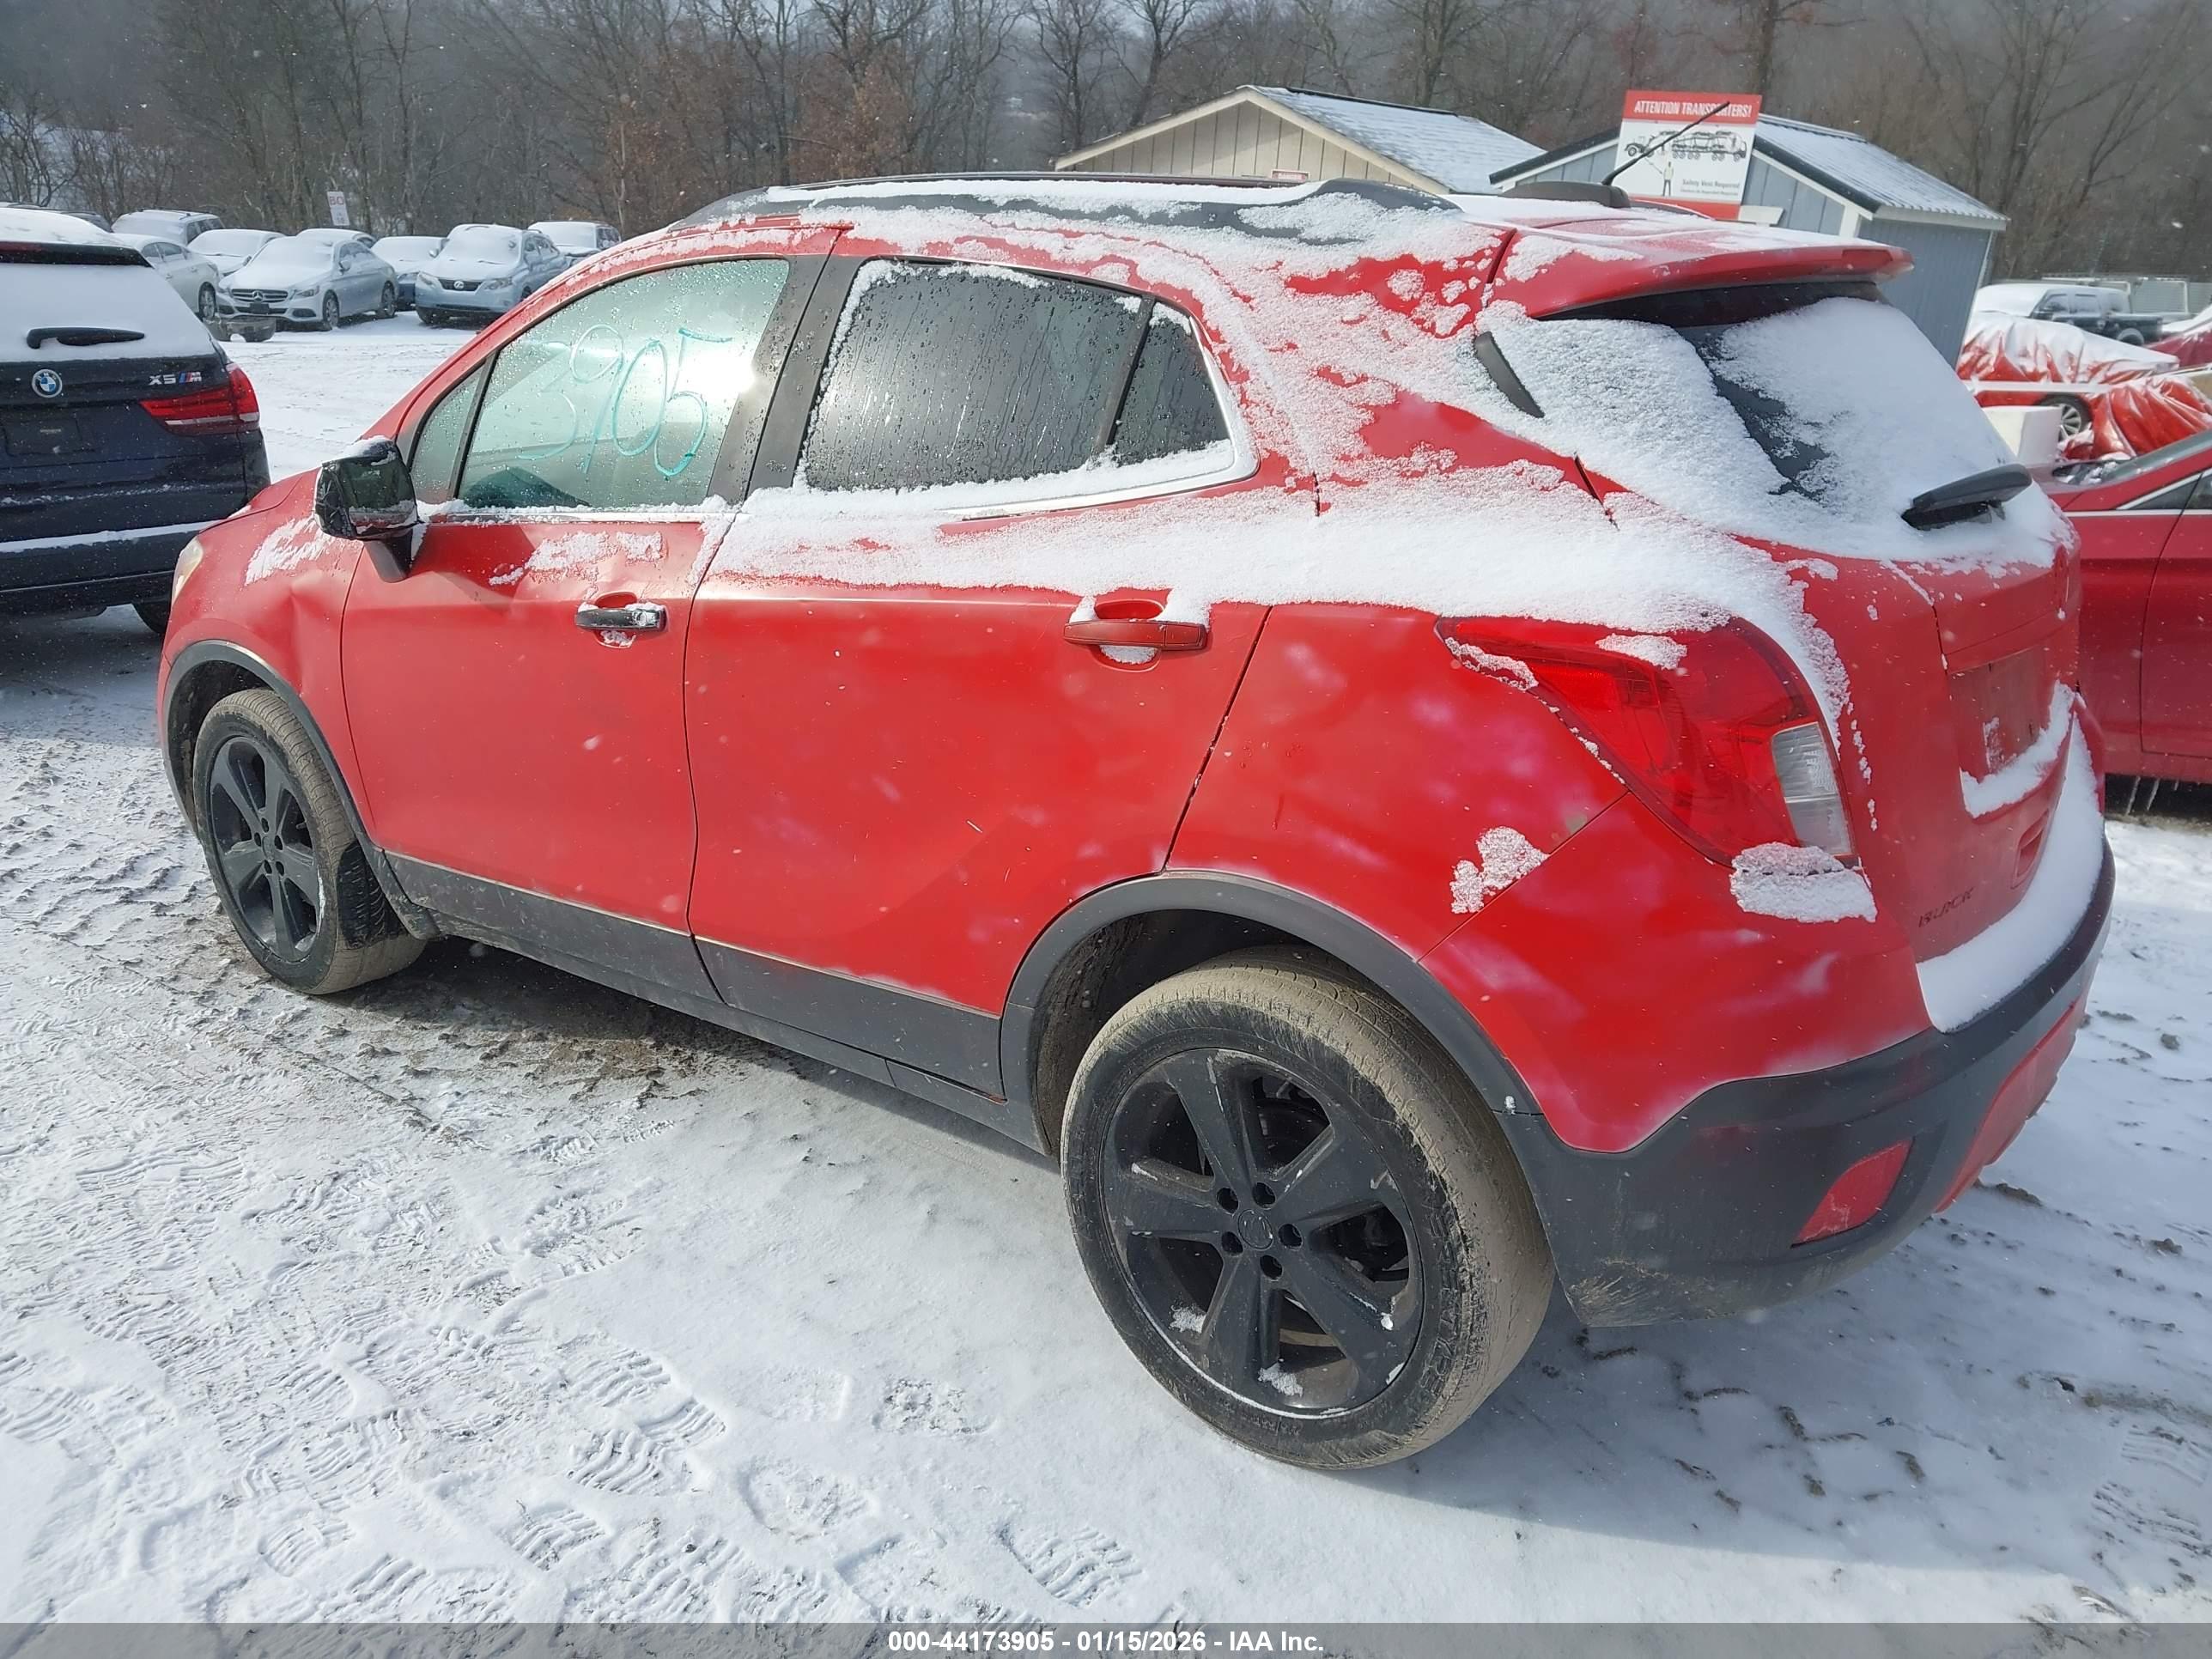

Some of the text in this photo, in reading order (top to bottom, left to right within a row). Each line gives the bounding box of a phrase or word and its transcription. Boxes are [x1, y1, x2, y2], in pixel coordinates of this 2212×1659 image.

[1634, 100, 1680, 114] ATTENTION
[149, 374, 176, 386] X5
[513, 324, 732, 477] 3905
